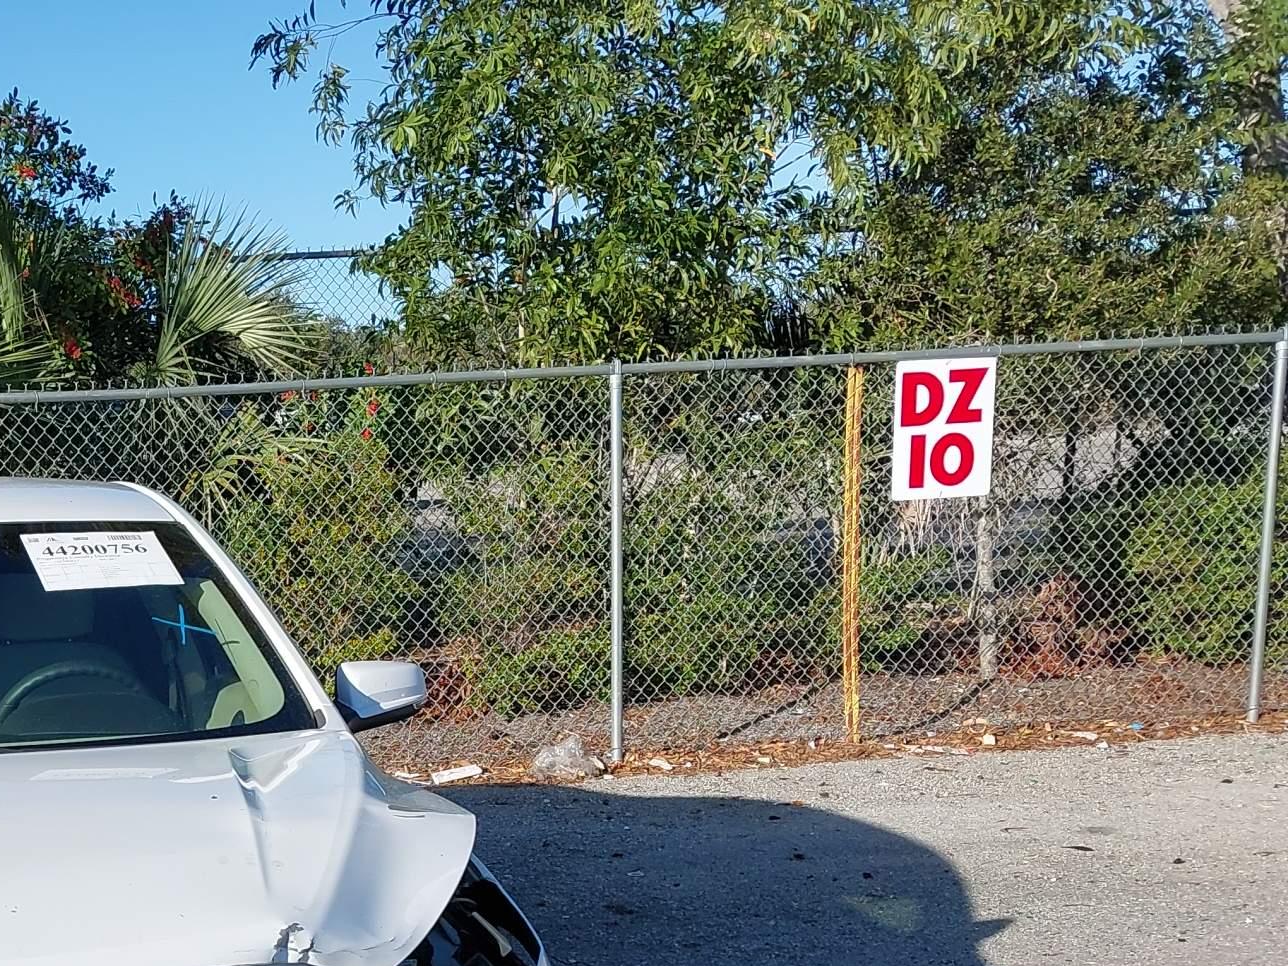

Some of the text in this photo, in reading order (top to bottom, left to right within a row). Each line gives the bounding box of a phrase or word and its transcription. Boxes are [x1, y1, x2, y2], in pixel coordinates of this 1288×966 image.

[900, 367, 990, 427] DZ
[908, 432, 975, 489] 10
[42, 543, 148, 557] 44200756
